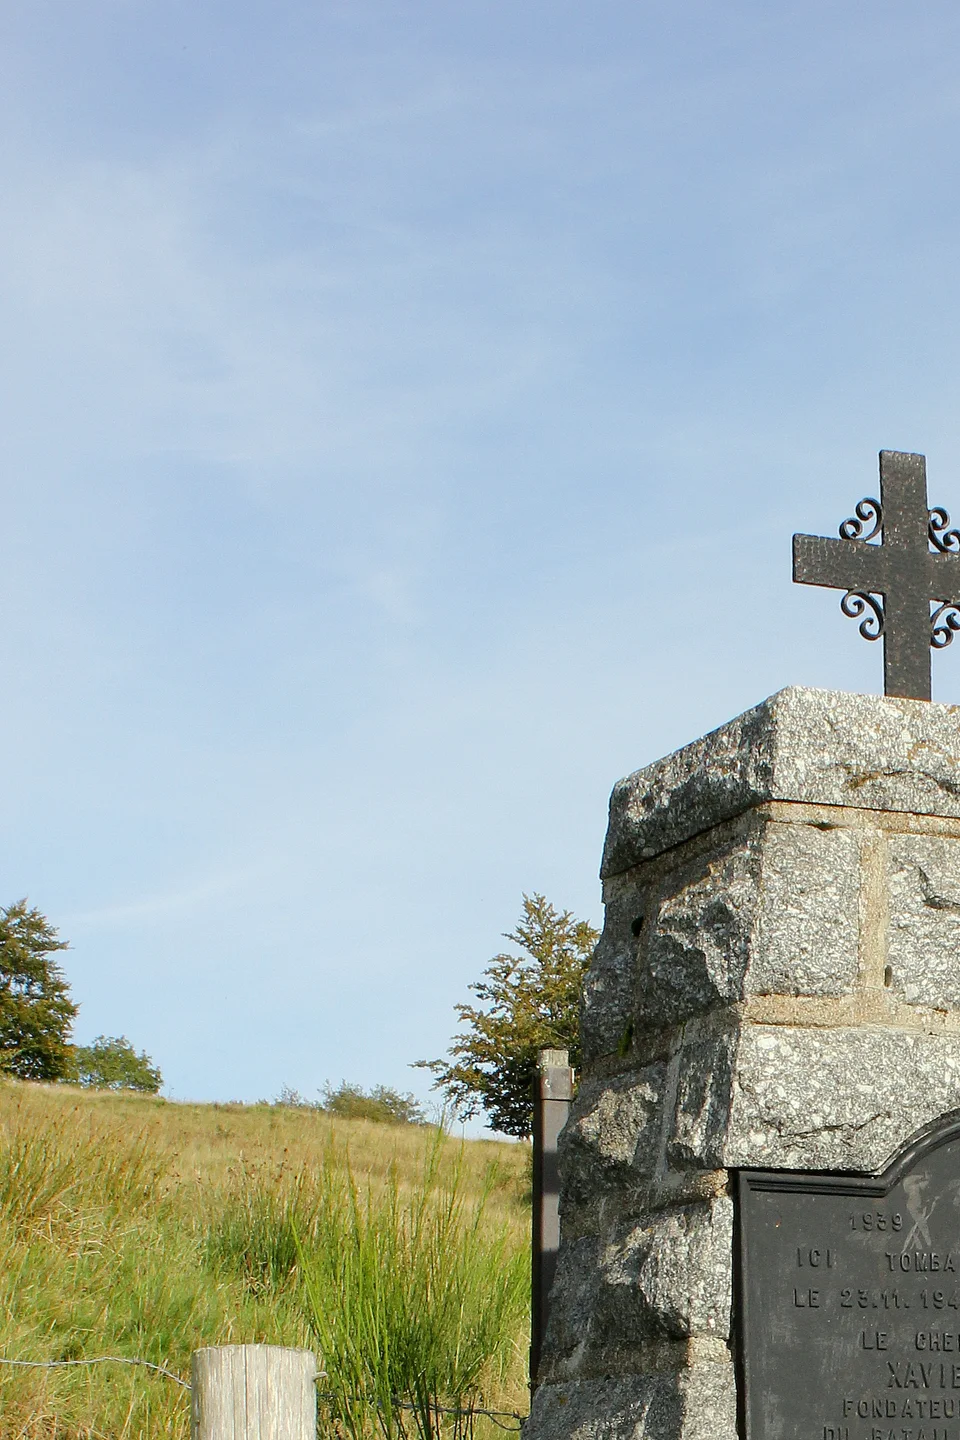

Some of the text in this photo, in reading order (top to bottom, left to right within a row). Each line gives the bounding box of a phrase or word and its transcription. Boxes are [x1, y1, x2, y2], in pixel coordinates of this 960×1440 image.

[849, 1211, 903, 1232] 1939
[796, 1247, 956, 1273] ICI TOMBA
[792, 1287, 820, 1309] LE
[861, 1331, 888, 1351] LE
